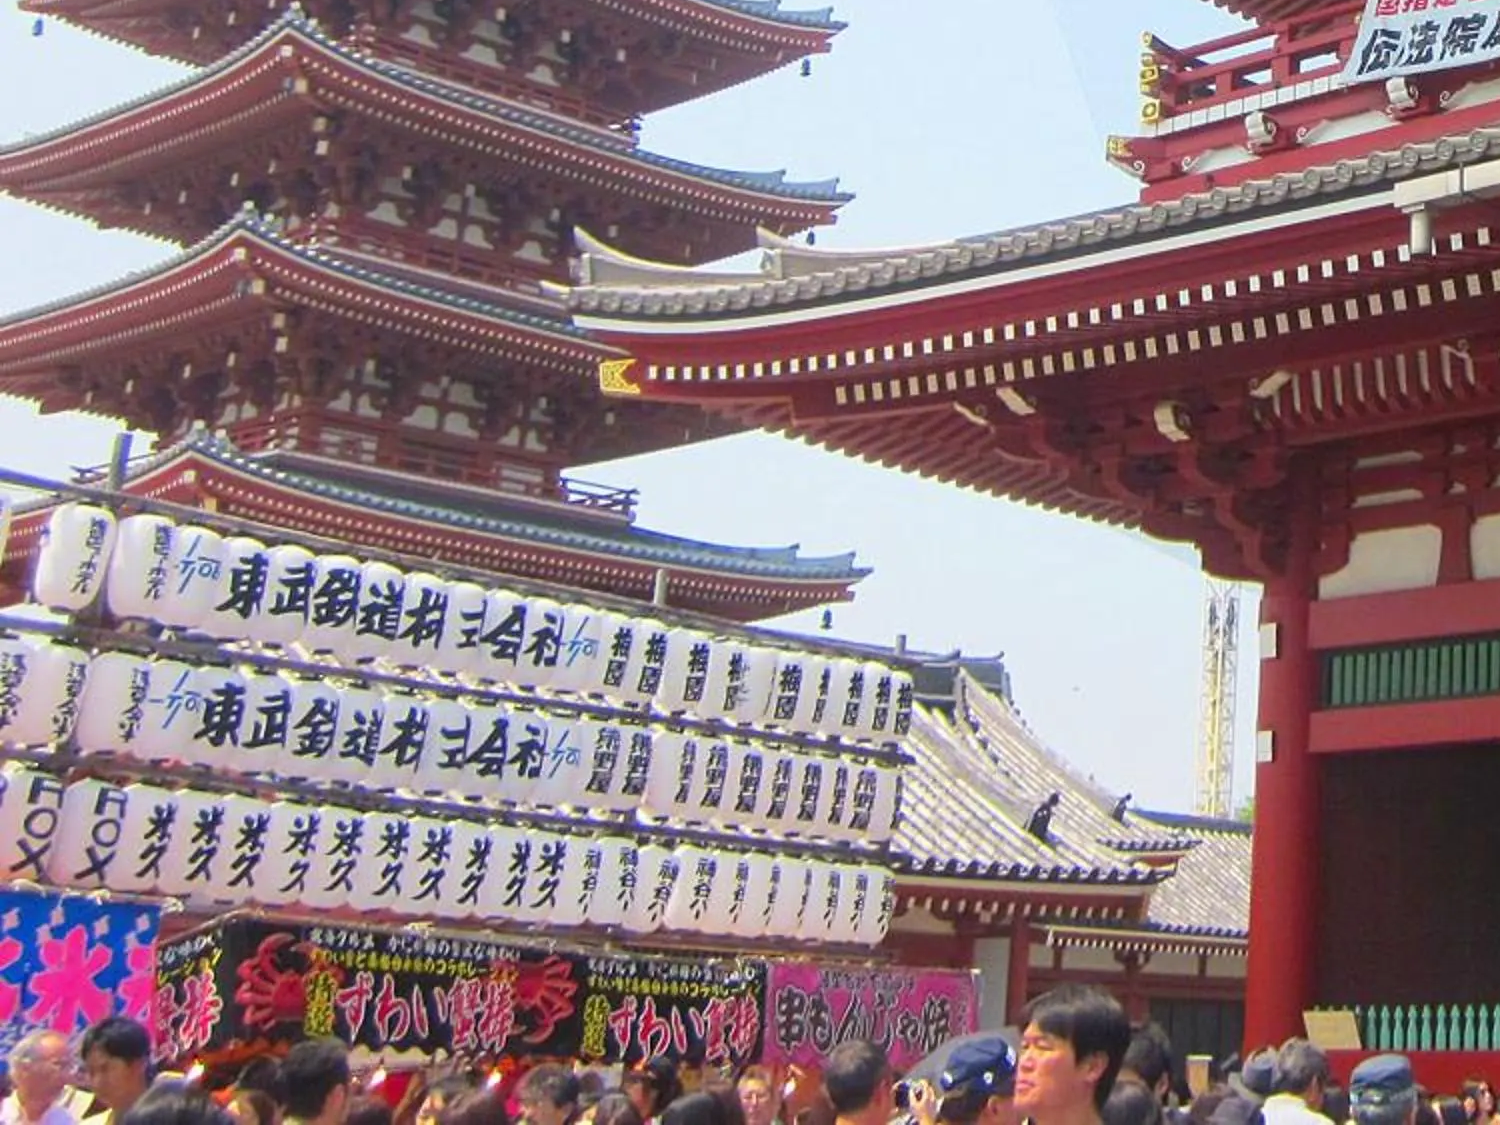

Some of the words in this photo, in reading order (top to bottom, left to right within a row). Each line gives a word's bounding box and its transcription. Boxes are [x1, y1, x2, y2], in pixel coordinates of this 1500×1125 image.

[603, 626, 633, 687] 梅園
[637, 632, 668, 696] 梅園
[683, 642, 710, 701] 梅園
[774, 663, 803, 720] 梅園
[74, 786, 128, 884] ROX
[136, 803, 179, 878] 米久
[185, 806, 225, 881] 米久
[227, 813, 271, 887] 米久
[280, 811, 321, 893] 米久
[324, 818, 364, 892] 米久
[372, 820, 411, 896] 米久
[411, 827, 452, 900] 米久
[457, 835, 494, 906] 米久
[502, 839, 532, 907] 米久
[530, 840, 567, 908] 米久
[617, 846, 639, 911] 神谷バー
[648, 859, 679, 922] 神谷バー
[689, 857, 717, 920] 神谷バー
